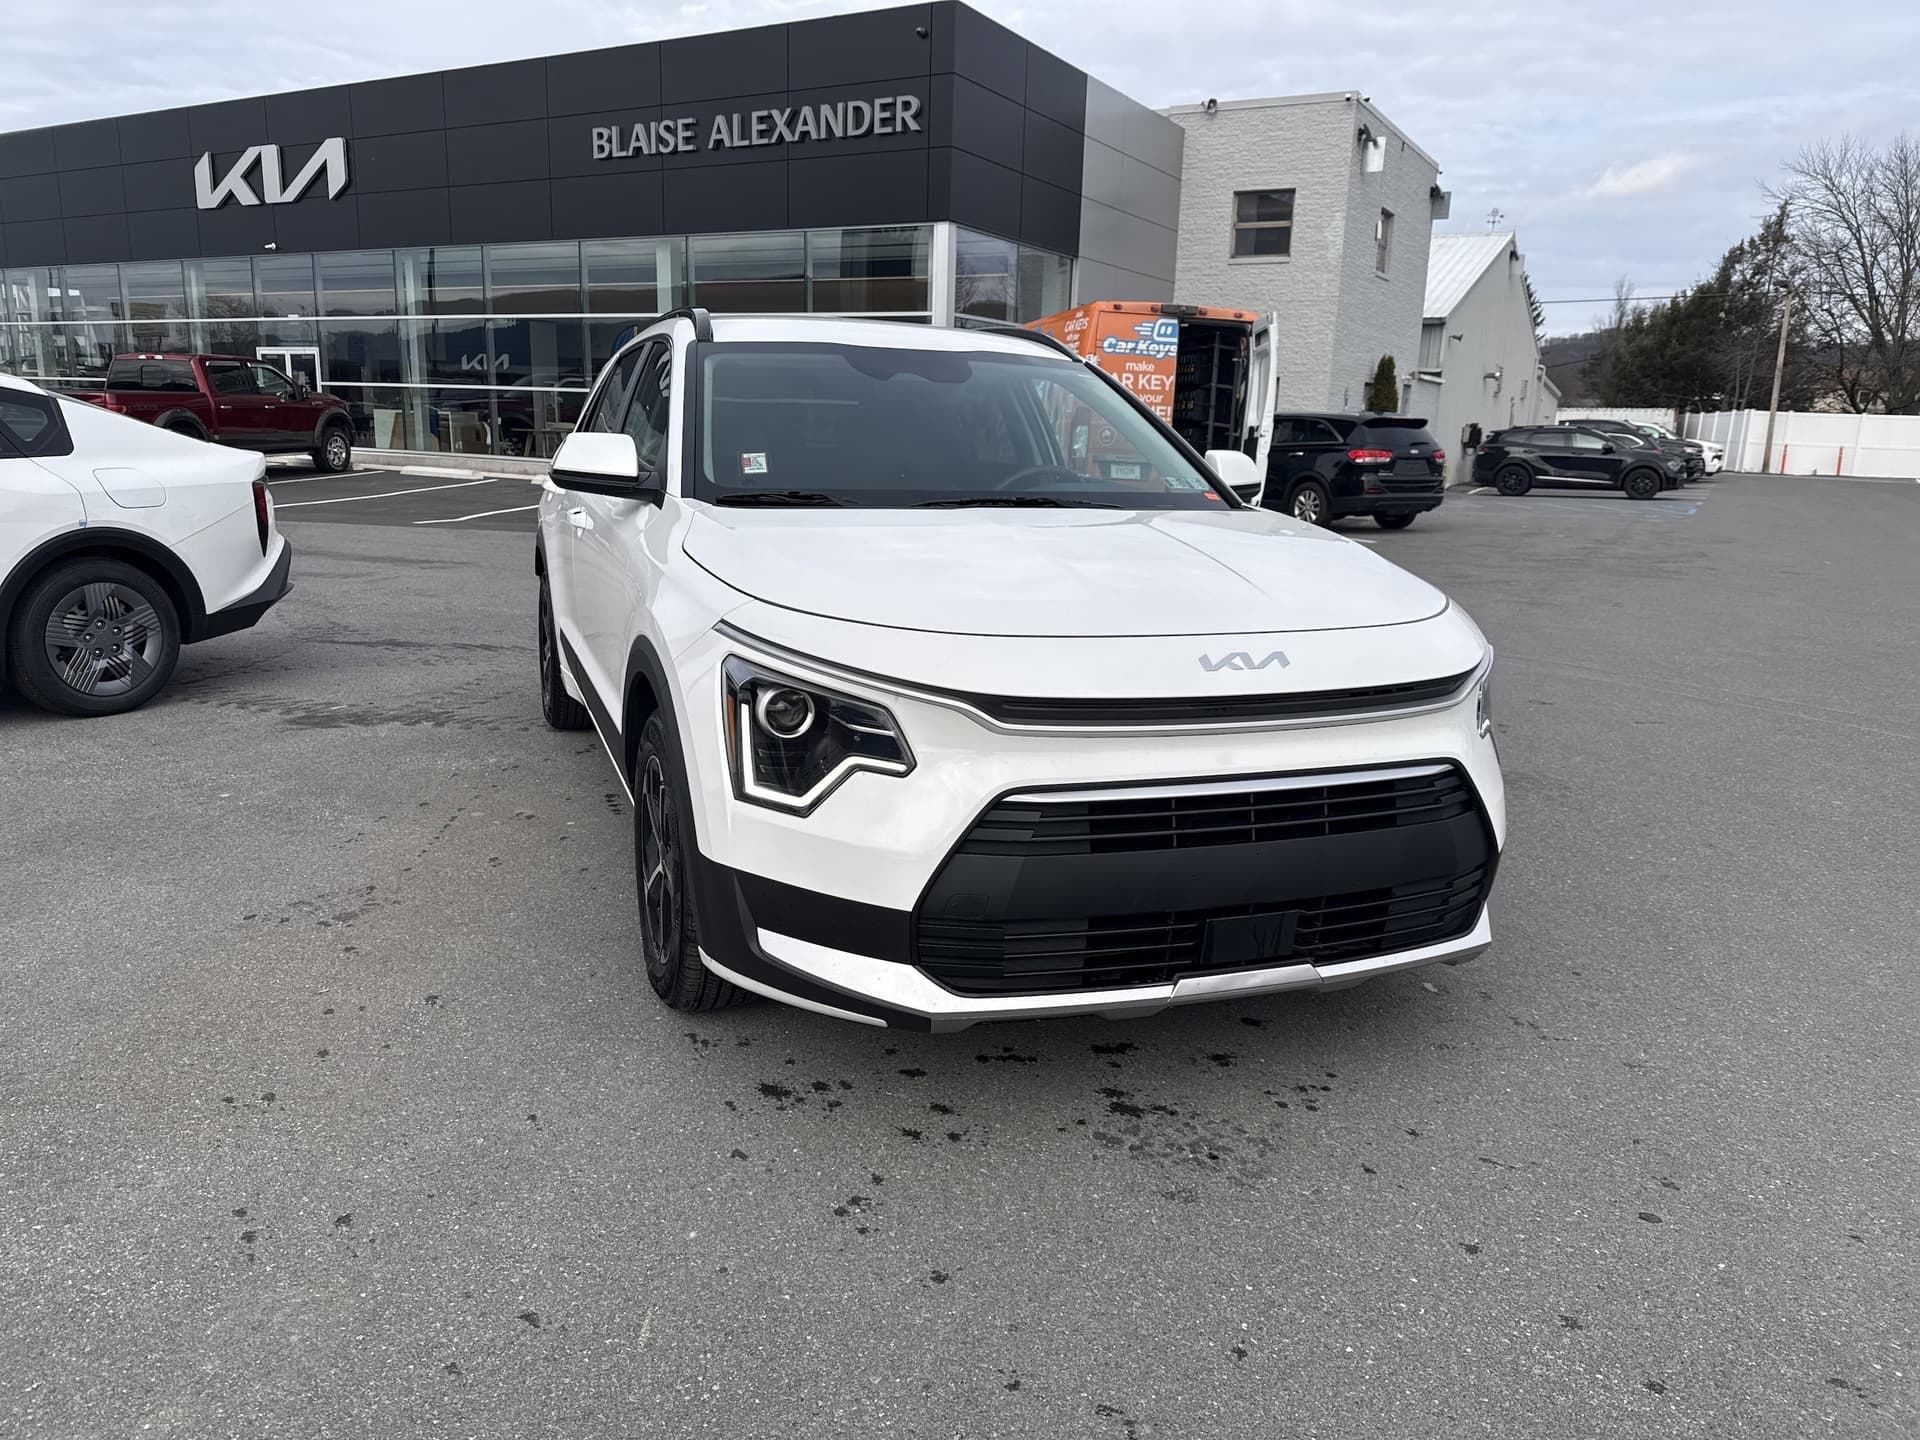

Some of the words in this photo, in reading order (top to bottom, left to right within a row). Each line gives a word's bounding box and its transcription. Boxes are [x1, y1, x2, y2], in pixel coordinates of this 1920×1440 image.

[592, 117, 697, 159] BLAISE
[708, 95, 922, 149] ALEXANDER
[194, 137, 348, 210] KIA
[1126, 360, 1155, 372] make
[1138, 373, 1174, 391] KEY
[1199, 650, 1290, 672] KIA
